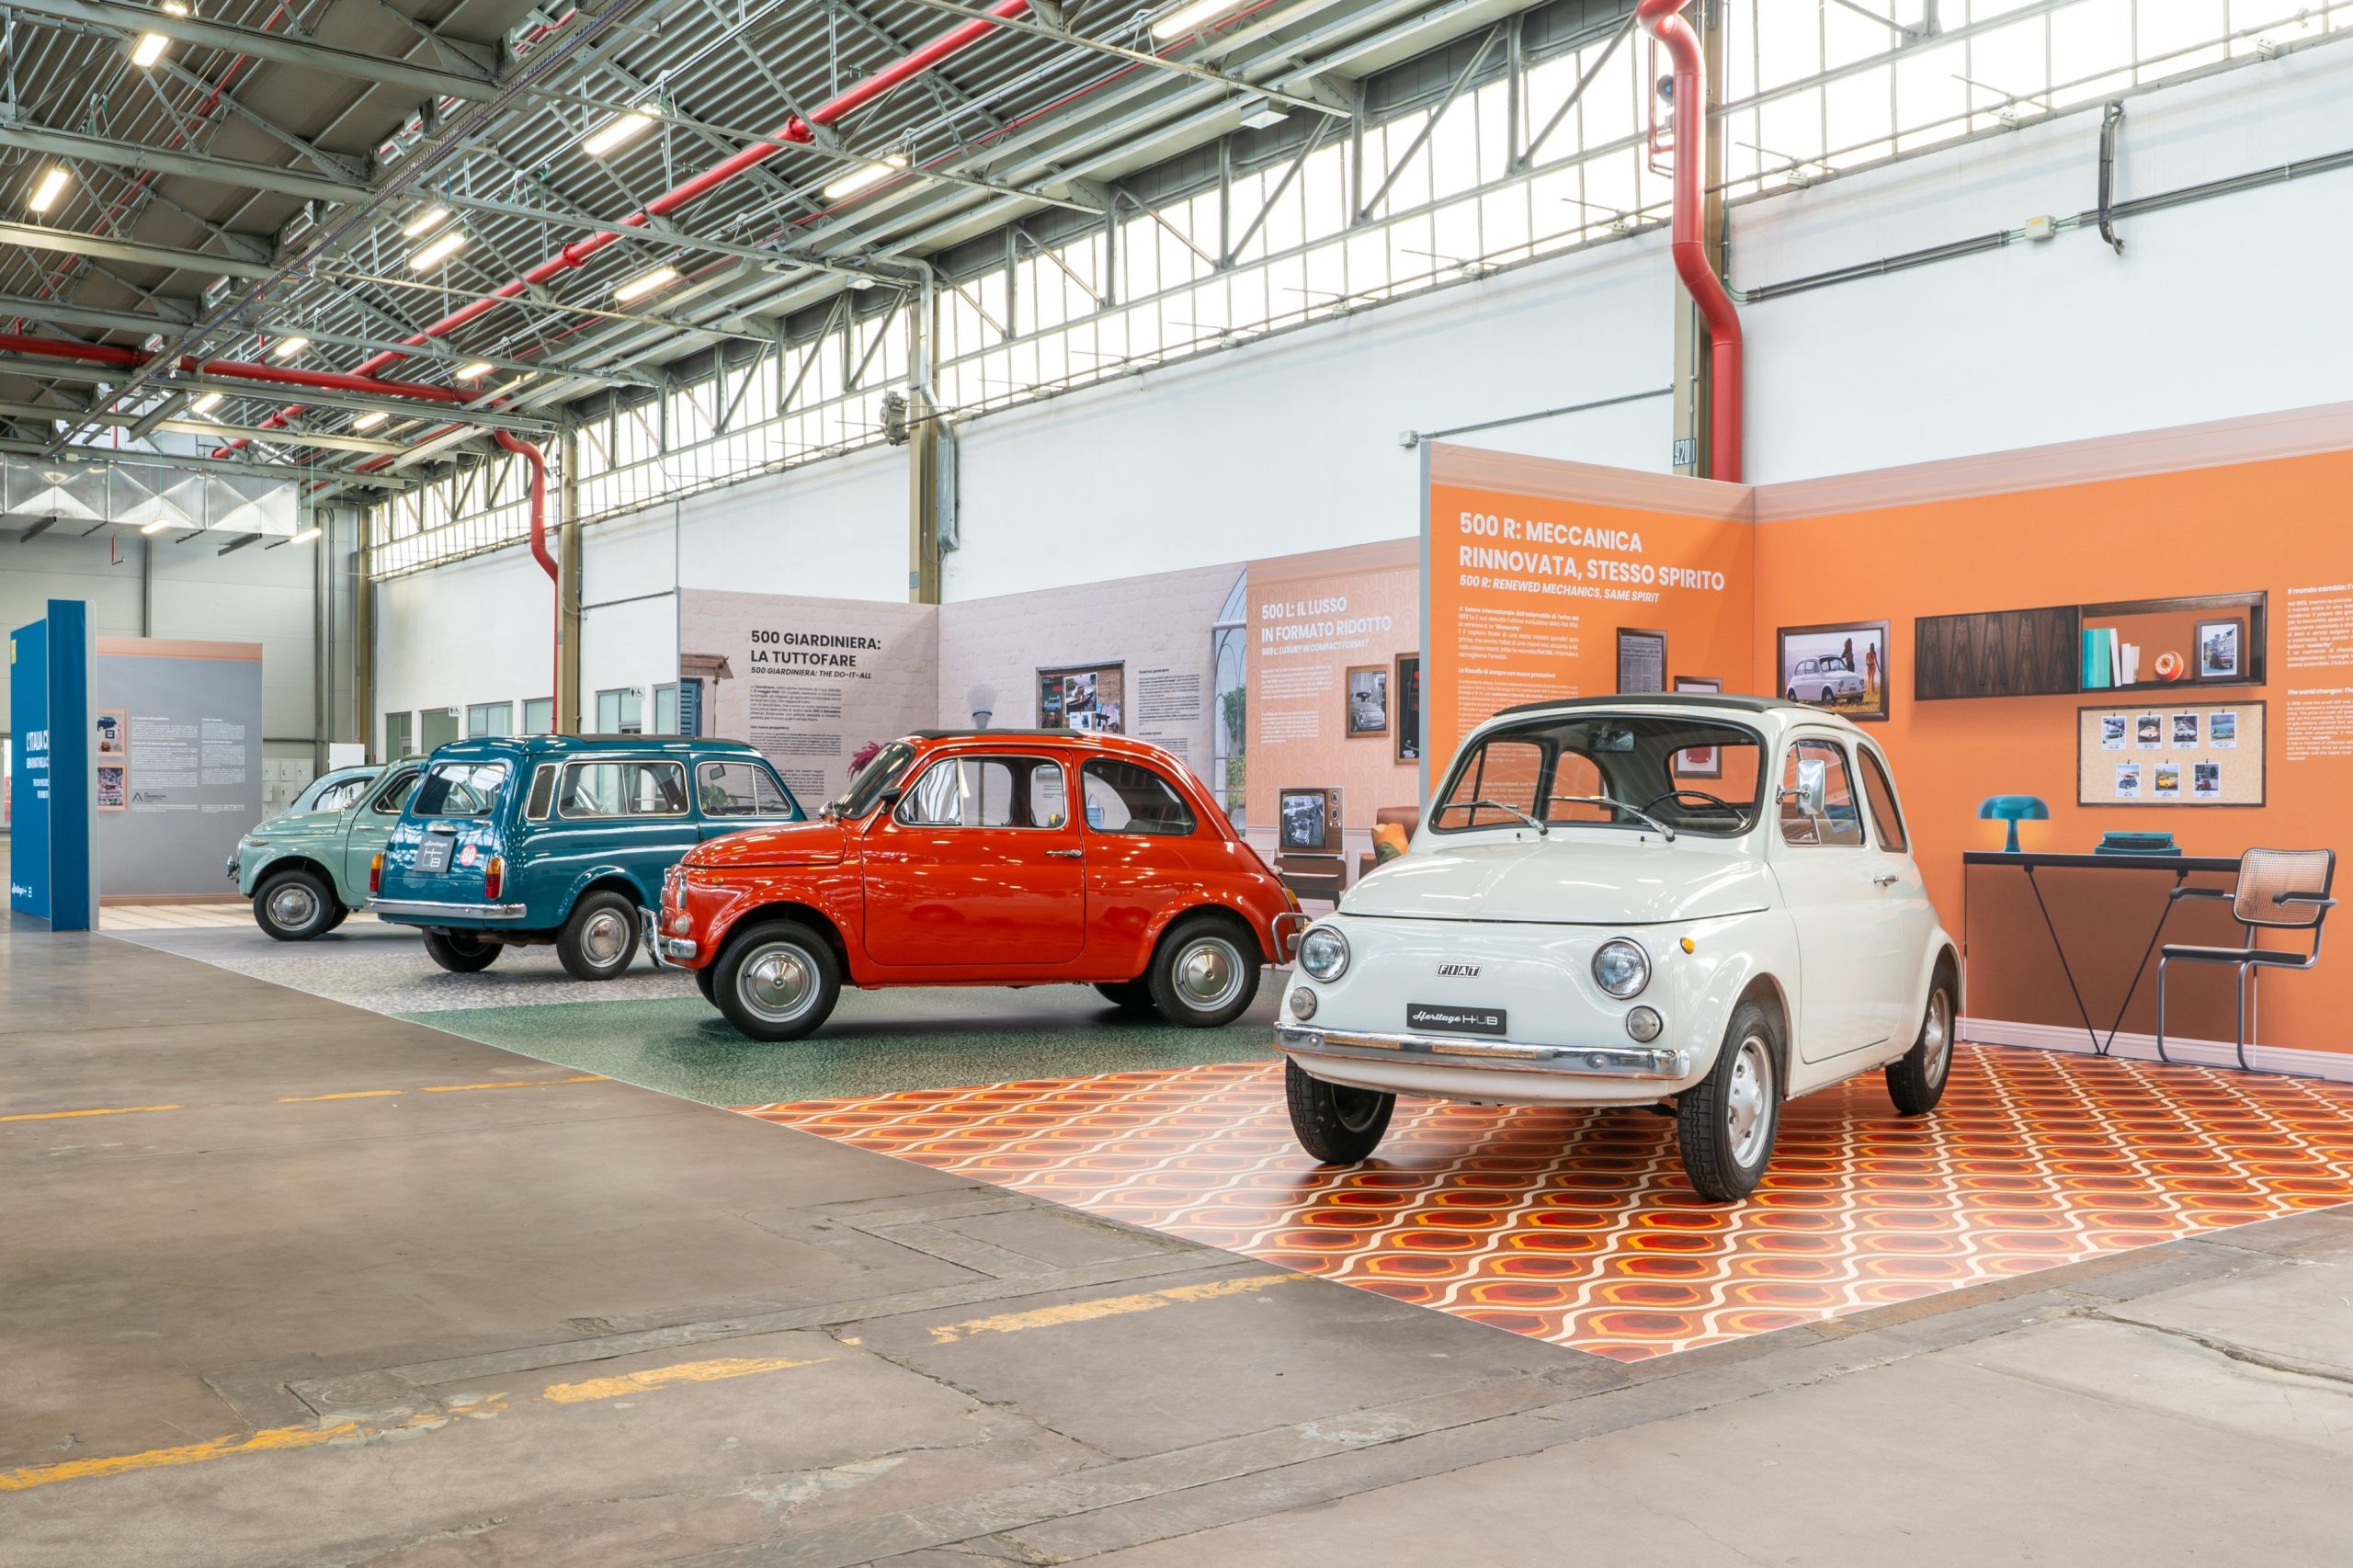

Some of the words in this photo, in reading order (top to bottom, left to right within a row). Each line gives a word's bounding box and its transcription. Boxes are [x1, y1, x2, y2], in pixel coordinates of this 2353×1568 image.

[1460, 511, 1499, 537] 500
[1503, 517, 1522, 540] R:
[1526, 520, 1643, 552] MECCANICA
[1459, 545, 1583, 581] RINNOVATA,
[1586, 559, 1655, 585] STESSO
[1658, 566, 1725, 591] SPIRITO
[1460, 574, 1481, 588] 500
[1482, 576, 1492, 589] R:
[1493, 577, 1541, 593] RENEWED
[1542, 583, 1603, 600] MECHANICS,
[1604, 587, 1631, 601] SAME
[1632, 590, 1660, 603] SPIRIT
[1262, 603, 1284, 620] 500
[1286, 602, 1295, 618] L:
[1297, 600, 1306, 617] IL
[1308, 596, 1347, 616] LUSSO
[1261, 627, 1274, 642] IN
[1276, 621, 1335, 642] FORMATO
[1336, 616, 1392, 636] RIDOTTO
[751, 630, 780, 644] 500
[783, 632, 881, 650] GIARDINIERA:
[1279, 644, 1302, 654] LUXURY
[1302, 643, 1310, 653] IN
[1310, 641, 1342, 653] COMPACT
[1342, 638, 1370, 649] FORMAT
[750, 649, 768, 663] LA
[772, 651, 857, 667] TUTTOFARE
[751, 665, 767, 675] 500
[767, 667, 818, 677] GIARDINIERA:
[834, 671, 872, 680] DO-IT-ALL
[1438, 964, 1481, 977] FIAT
[1413, 1010, 1461, 1025] Heritage
[1462, 1014, 1498, 1026] HUB
